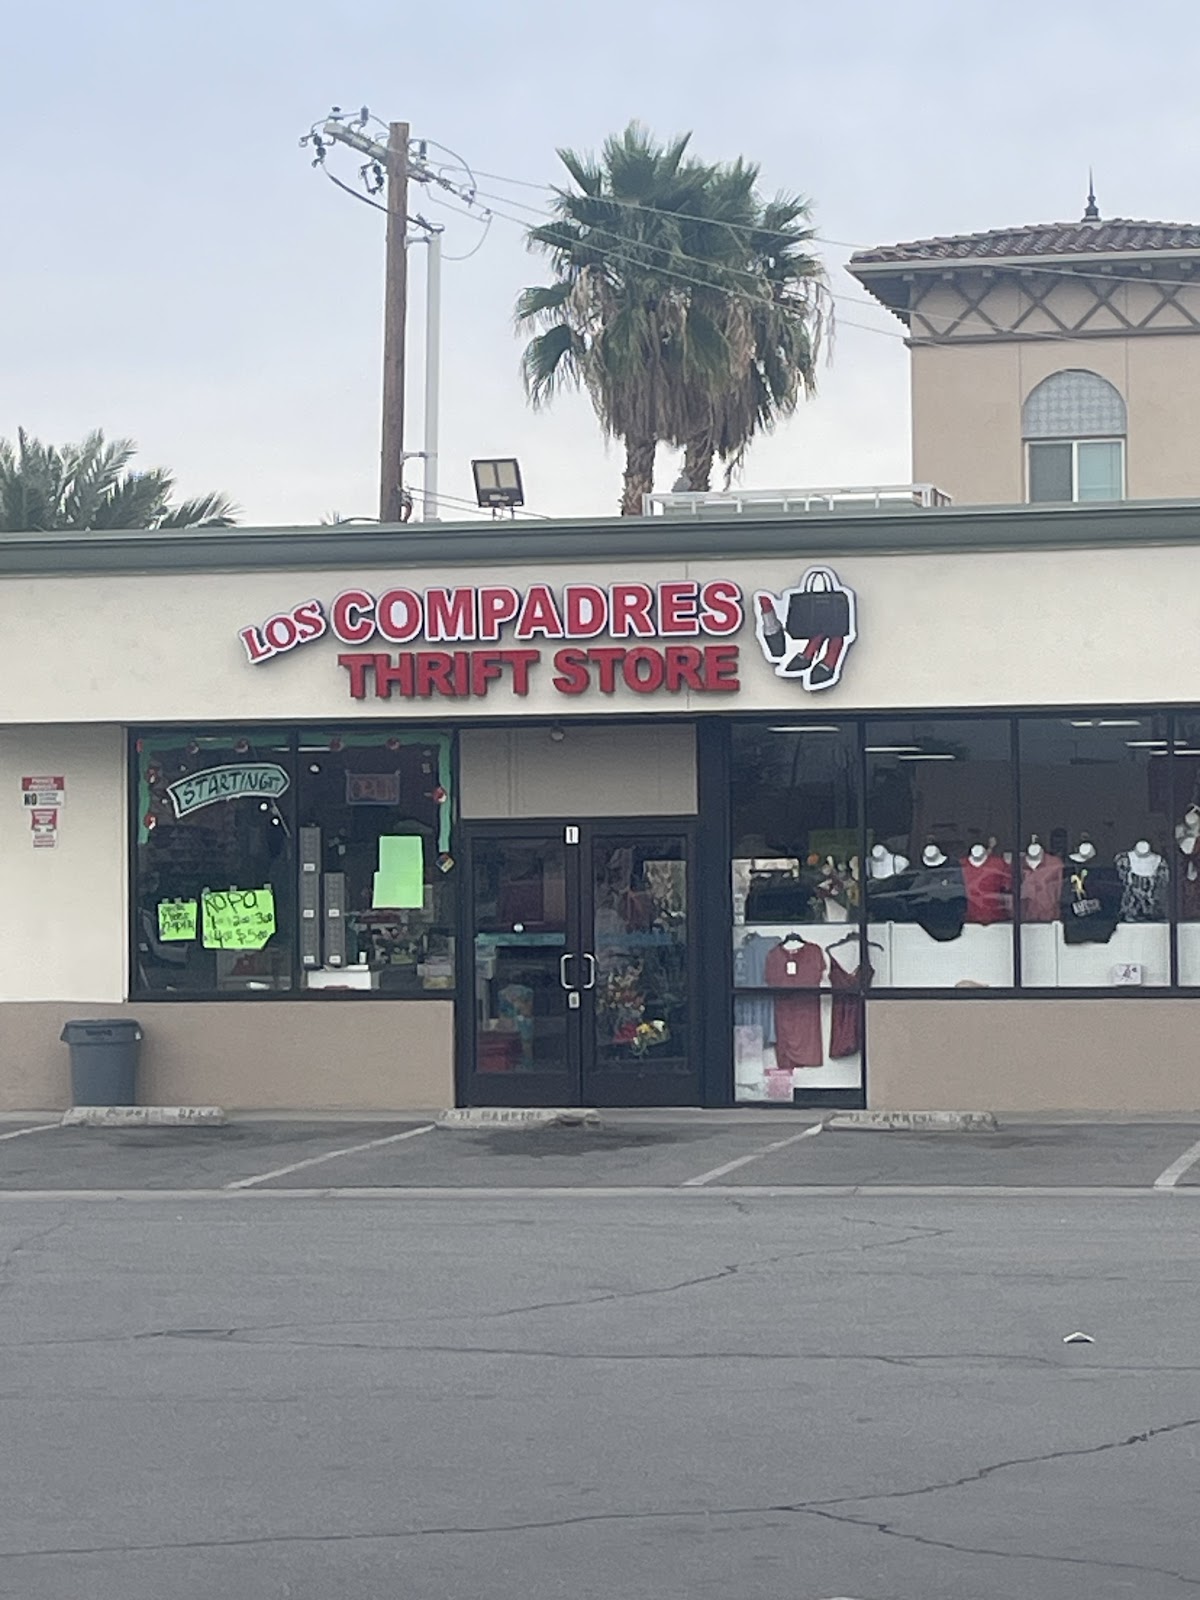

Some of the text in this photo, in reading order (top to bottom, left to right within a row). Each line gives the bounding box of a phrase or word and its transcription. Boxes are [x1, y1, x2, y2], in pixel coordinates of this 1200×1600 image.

[240, 582, 742, 663] LOS COMPADRES
[338, 645, 740, 699] THRIFT STORE
[24, 793, 37, 806] NO
